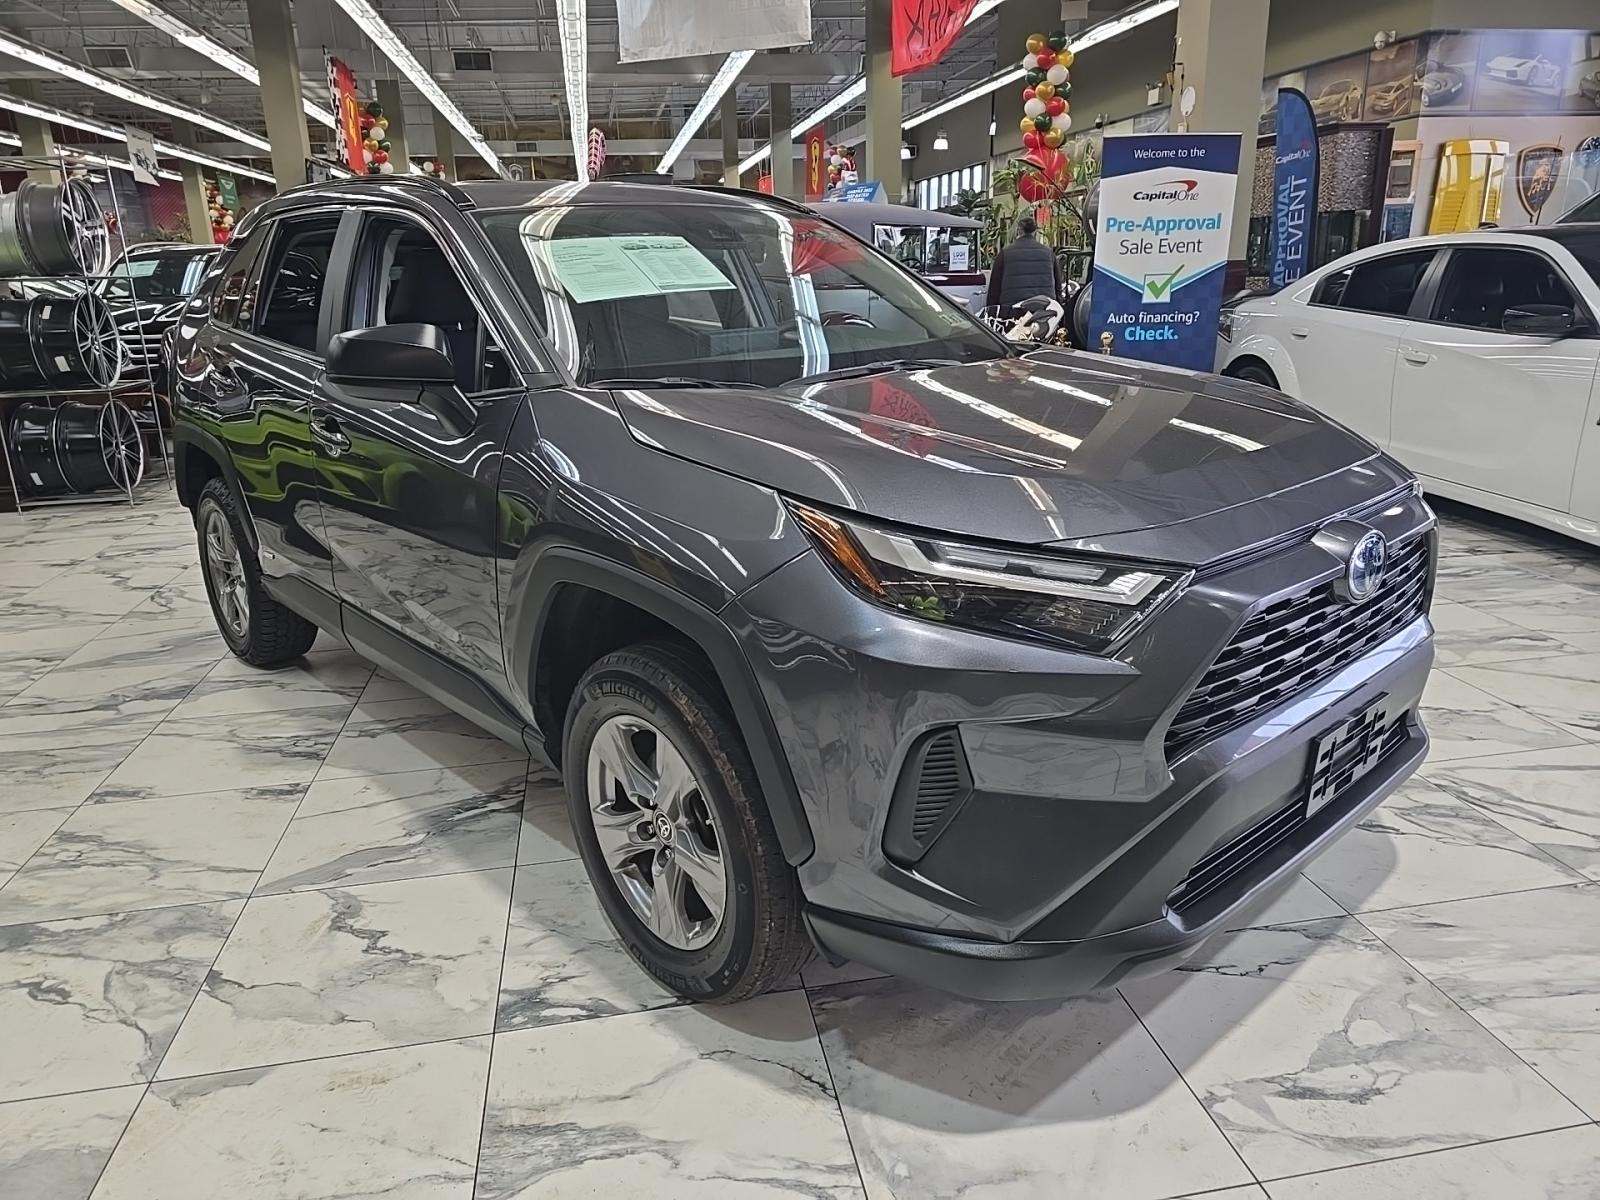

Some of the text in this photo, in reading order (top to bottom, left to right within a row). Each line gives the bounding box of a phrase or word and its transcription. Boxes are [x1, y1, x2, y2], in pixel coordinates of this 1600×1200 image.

[1133, 146, 1206, 159] Welcome to the
[1105, 212, 1222, 236] Pre-Approval
[1286, 174, 1307, 261] EVENT
[1119, 238, 1203, 255] Sale Event
[1107, 310, 1200, 325] Auto financing?
[1124, 325, 1179, 341] Check.
